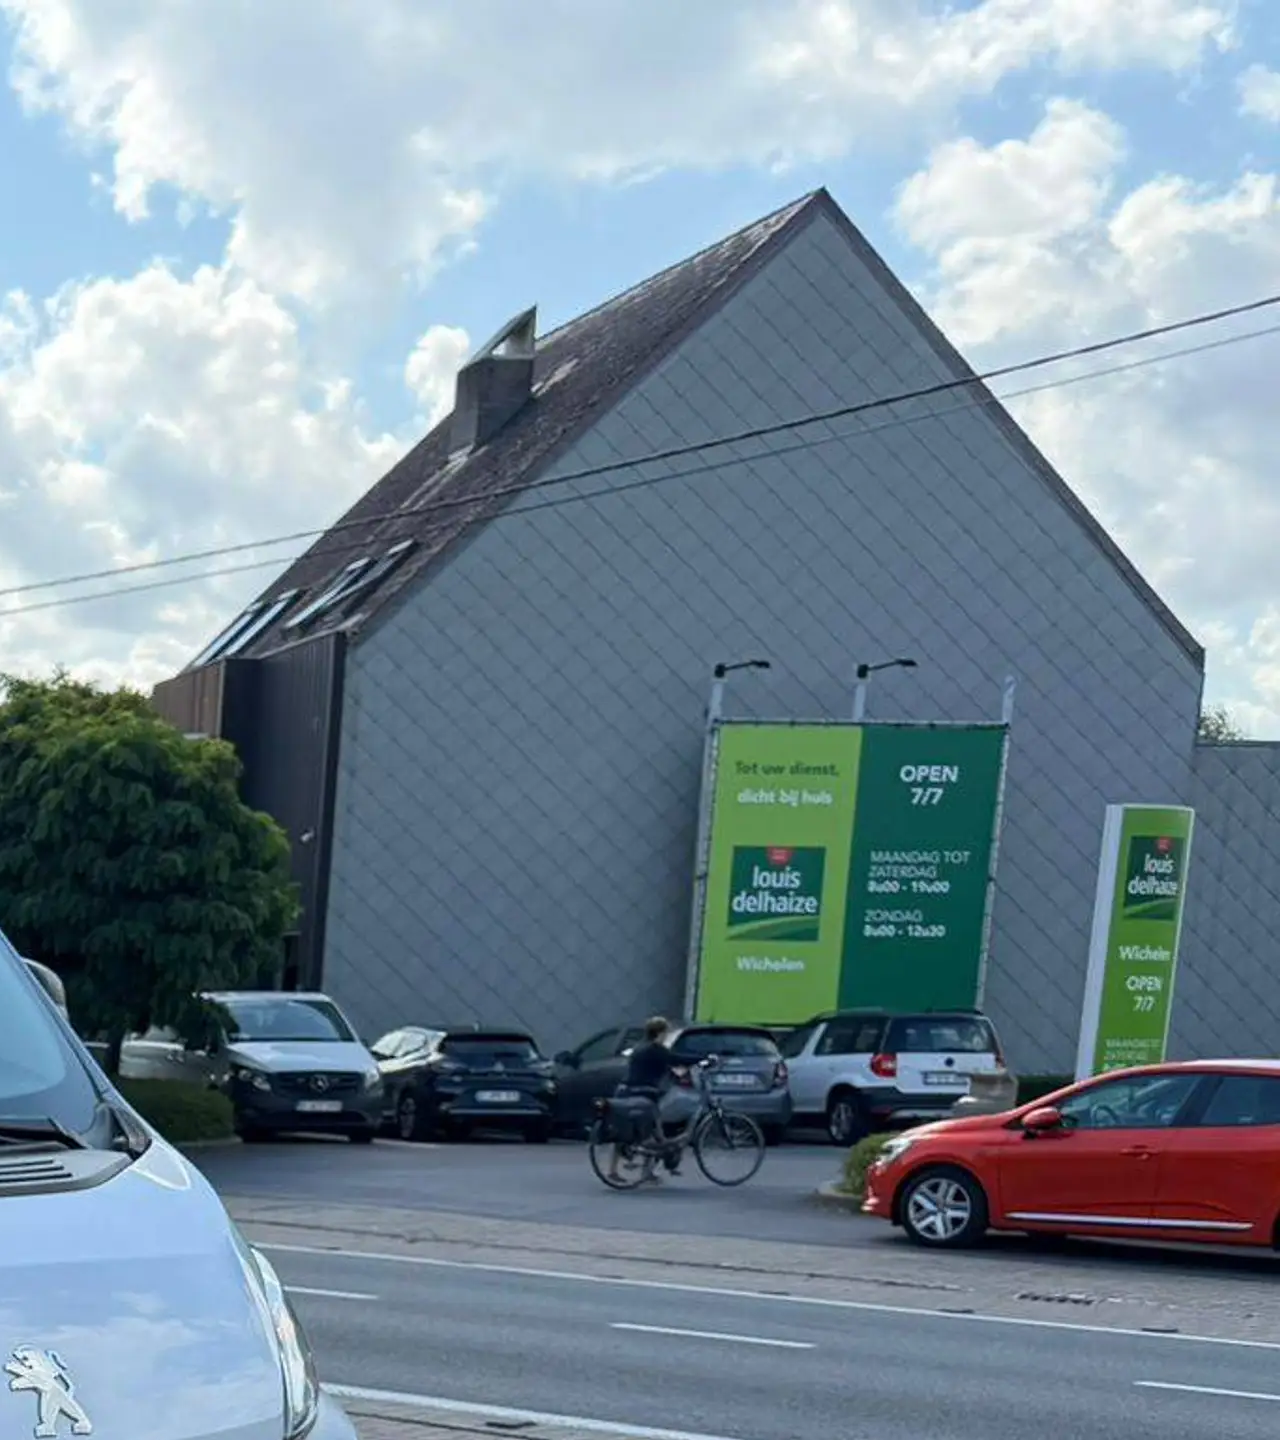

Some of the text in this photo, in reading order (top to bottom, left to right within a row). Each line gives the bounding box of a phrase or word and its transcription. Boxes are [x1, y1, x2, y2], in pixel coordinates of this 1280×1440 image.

[736, 761, 758, 775] Tot
[761, 764, 785, 775] uw
[900, 765, 958, 782] OPEN
[738, 789, 775, 804] dicht
[910, 787, 943, 805] 7/7
[870, 850, 971, 864] MAANDAG TOT
[1144, 853, 1174, 873] louis
[753, 866, 801, 889] louis
[1128, 875, 1180, 895] delhaize
[732, 891, 818, 913] delhaize
[864, 909, 923, 922] ZONDAG
[1126, 975, 1161, 991] OPEN
